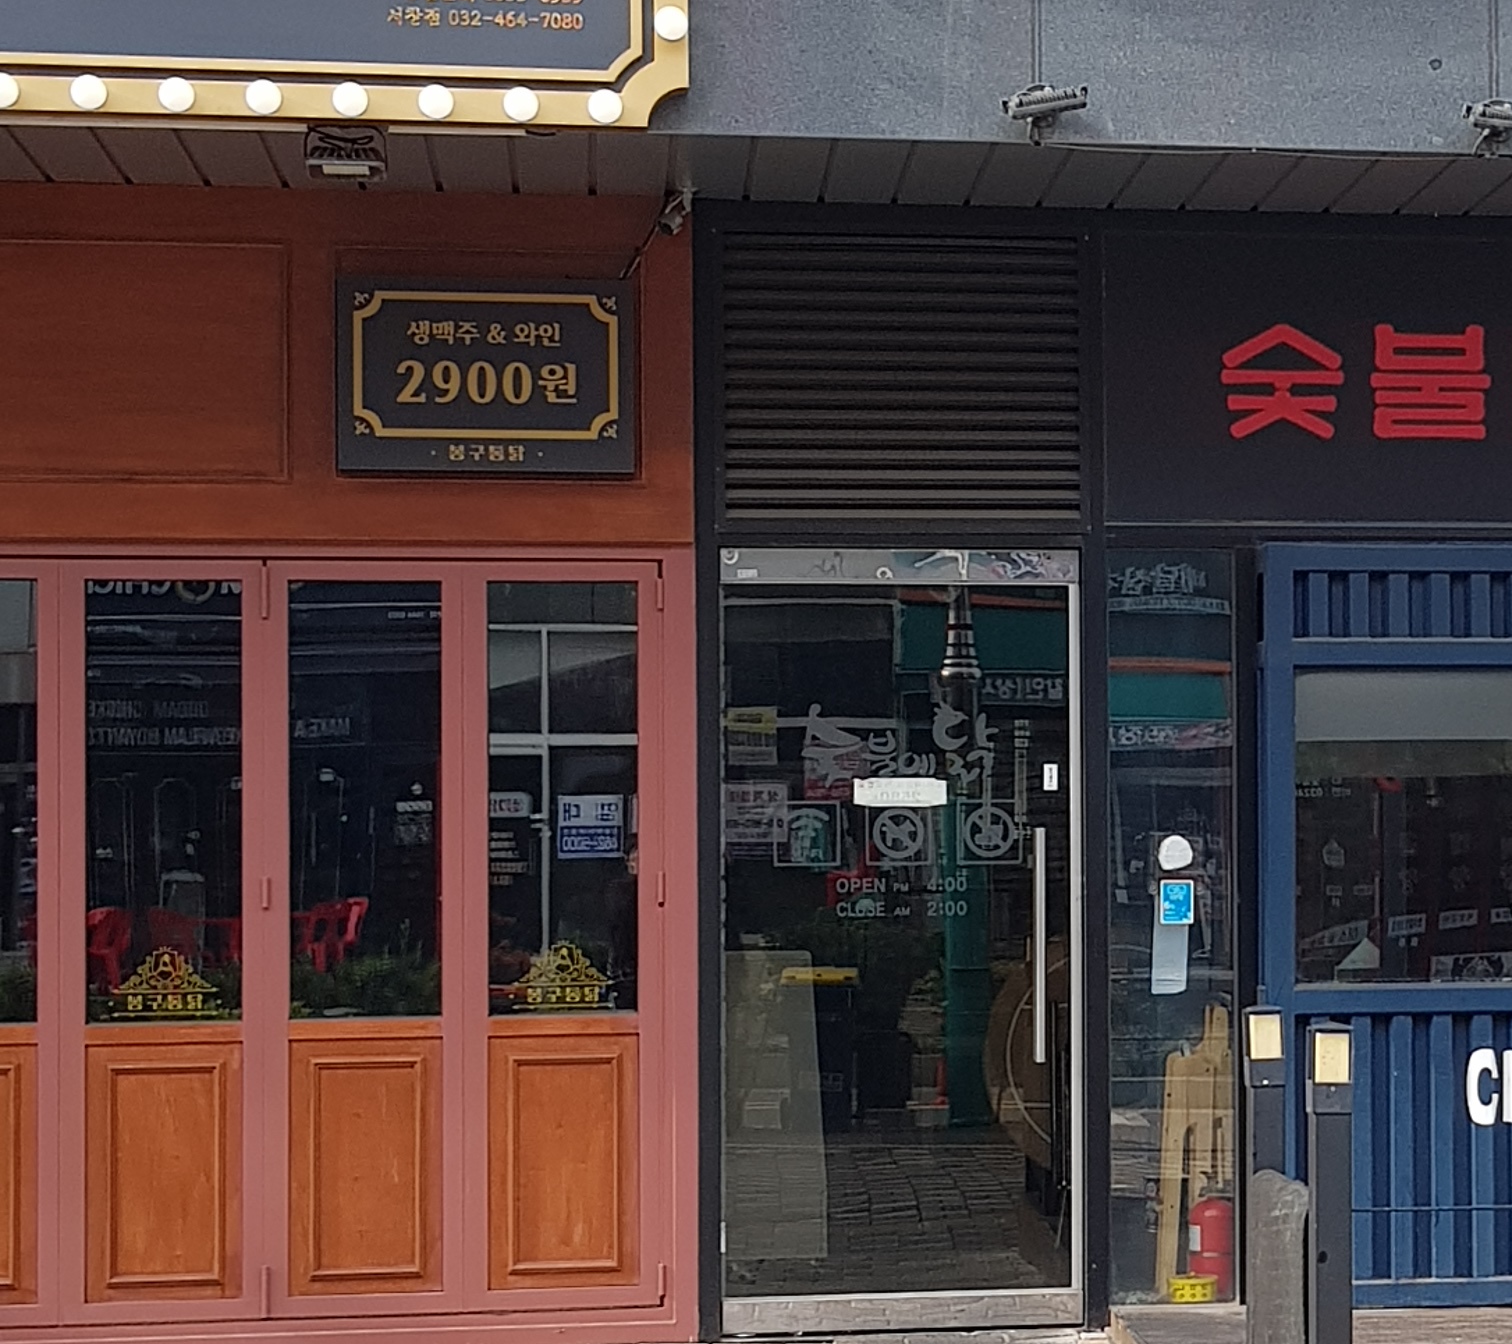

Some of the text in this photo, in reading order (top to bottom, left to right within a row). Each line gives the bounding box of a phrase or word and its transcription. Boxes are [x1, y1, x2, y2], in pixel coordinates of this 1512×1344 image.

[387, 7, 584, 30] 서창점 032-464-7080
[406, 320, 561, 347] 생맥주 & 와인
[396, 359, 578, 405] 2900원
[448, 444, 525, 462] 봉구통닭
[836, 877, 968, 894] OPEN PM 4:00
[836, 901, 968, 917] CLOSE AM 2:00
